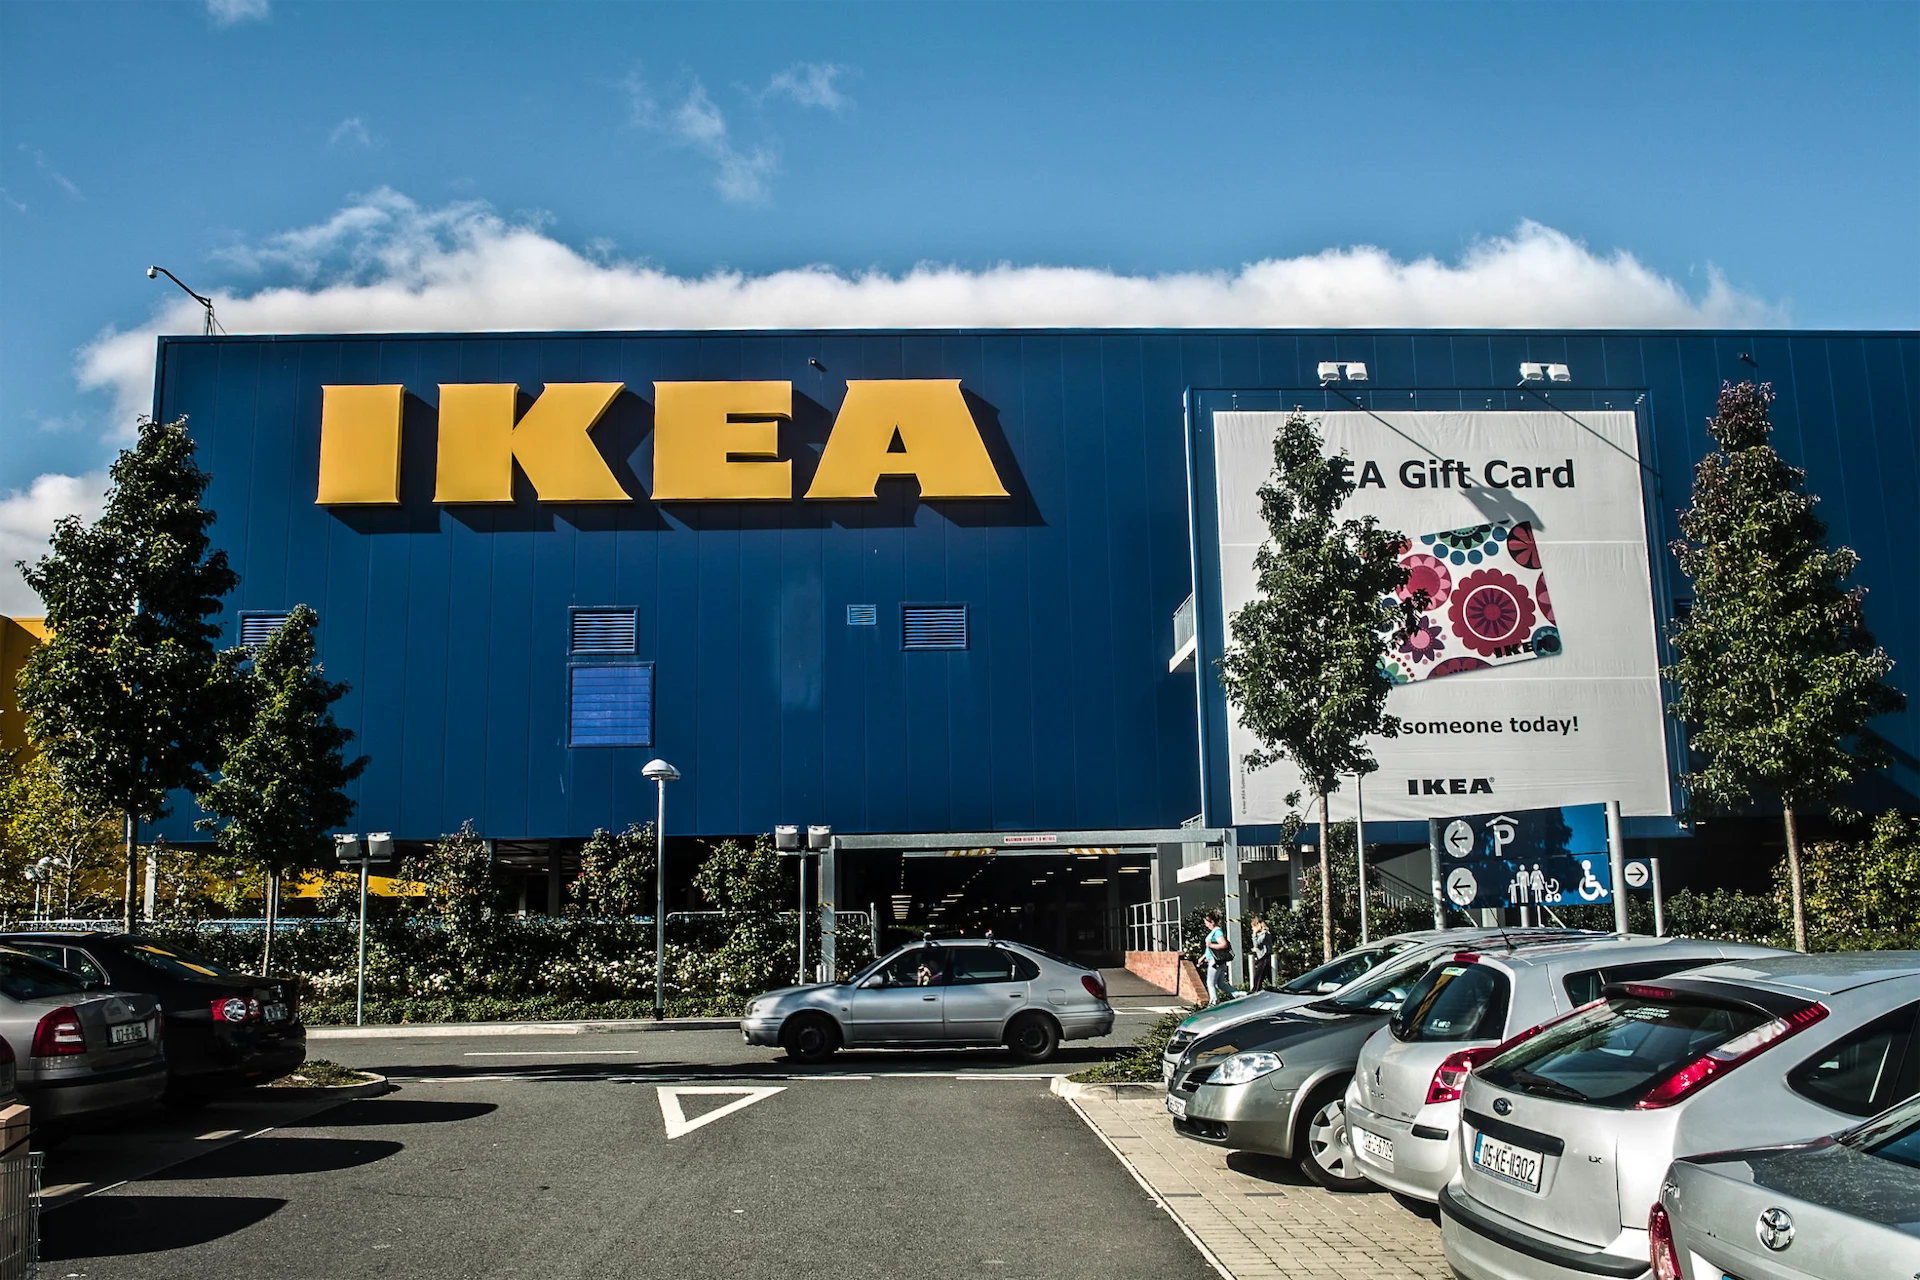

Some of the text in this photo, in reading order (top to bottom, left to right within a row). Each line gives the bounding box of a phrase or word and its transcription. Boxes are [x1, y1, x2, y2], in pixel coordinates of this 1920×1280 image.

[315, 379, 1010, 504] IKEA
[1399, 459, 1472, 489] Gift
[1484, 458, 1575, 489] Card
[1402, 719, 1503, 735] someone
[1510, 716, 1579, 736] today!
[1493, 823, 1515, 857] P
[1482, 1143, 1536, 1183] 05-KE-11302
